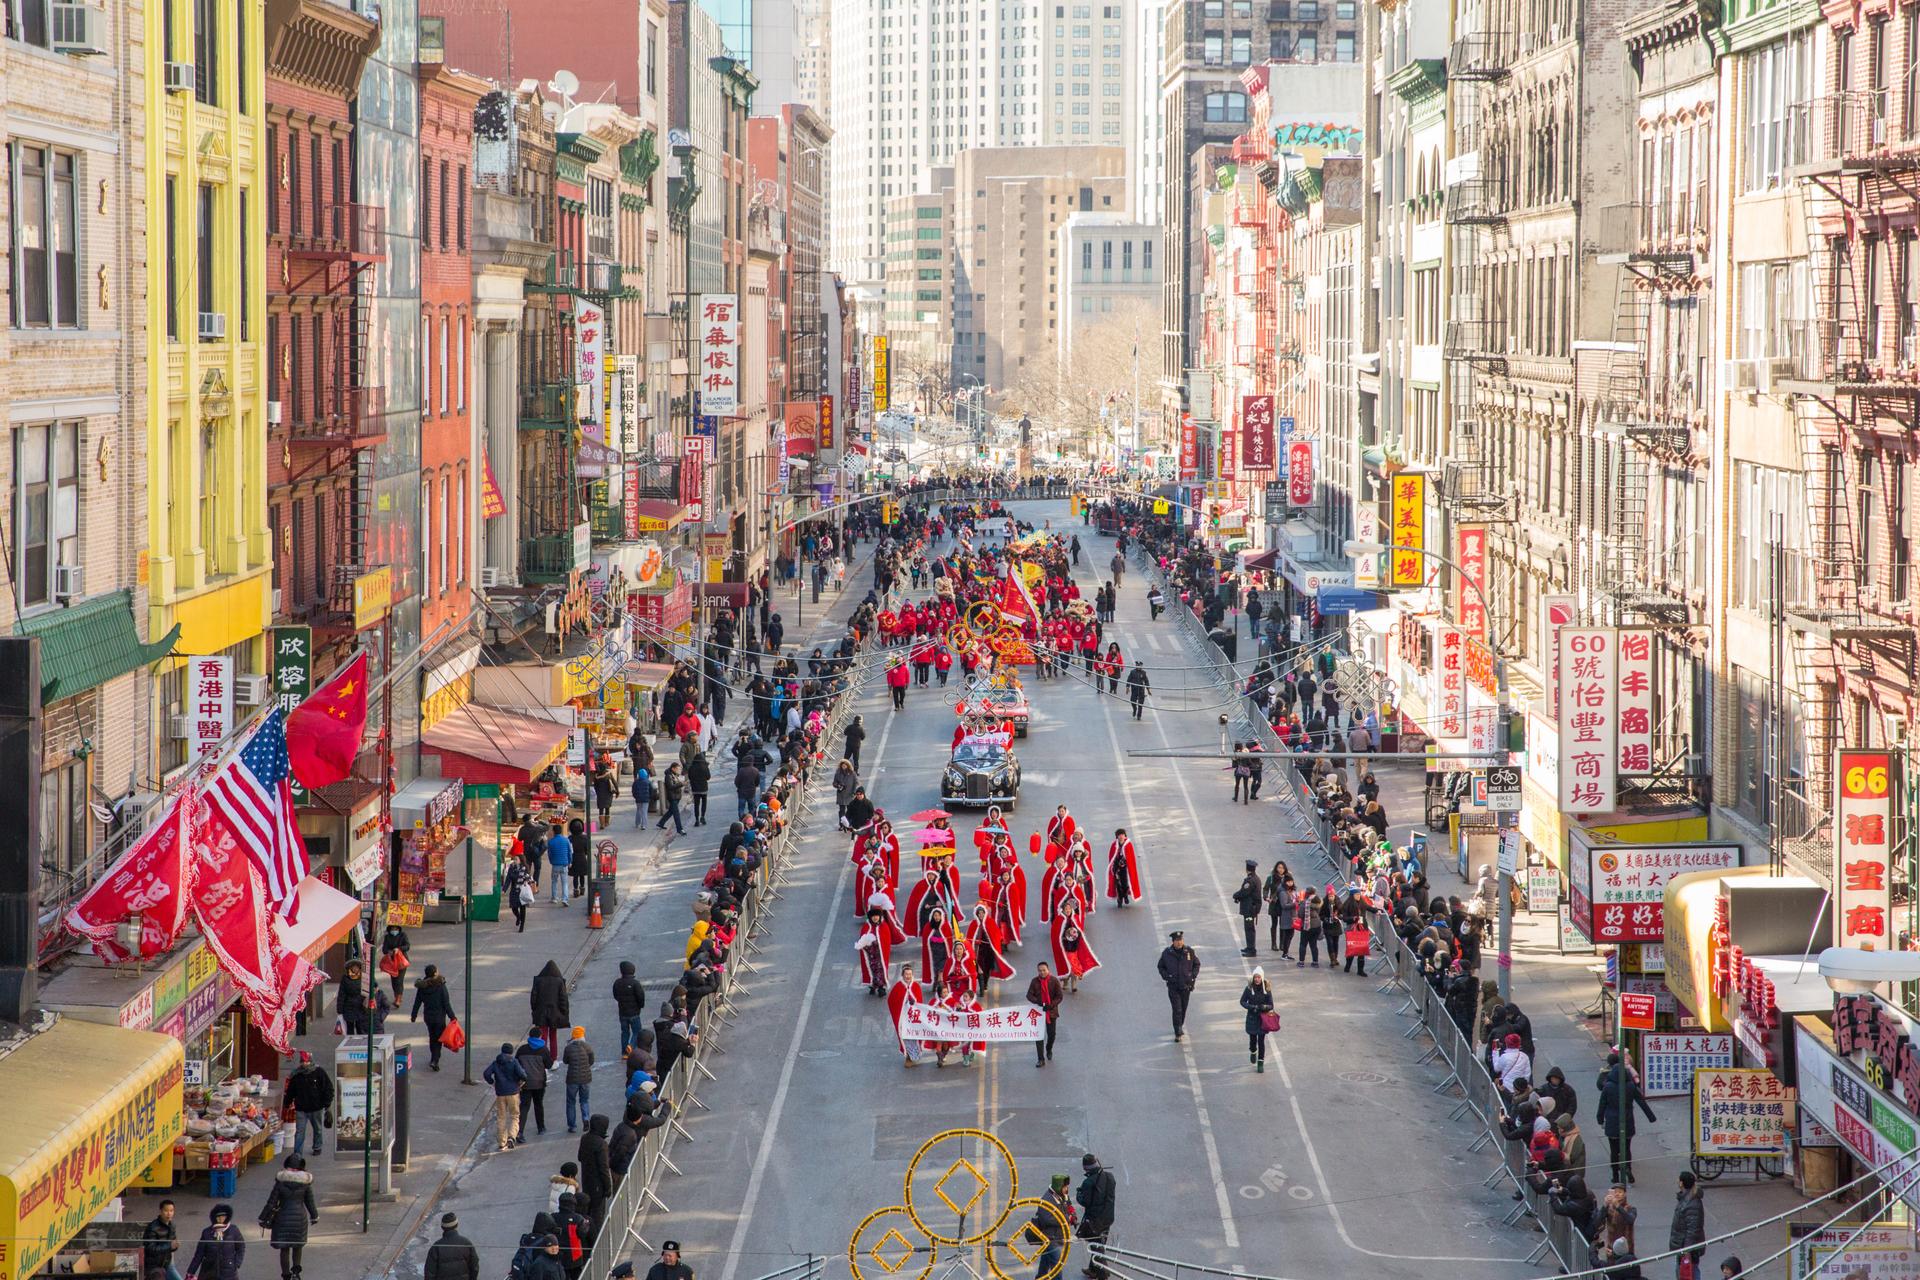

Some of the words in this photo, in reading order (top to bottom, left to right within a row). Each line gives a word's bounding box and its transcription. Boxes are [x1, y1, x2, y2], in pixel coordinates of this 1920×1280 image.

[1397, 480, 1420, 580] 華美商場
[1443, 632, 1461, 734] 興旺旺商場
[1846, 766, 1888, 794] 66
[1845, 813, 1885, 936] 福宝商
[1606, 927, 1618, 935] 62
[1633, 927, 1649, 935] TEL
[1626, 1003, 1649, 1011] ANYTIME
[1631, 996, 1653, 1004] STANDING
[906, 1006, 1043, 1030] 紐約中國旗袍會
[906, 1027, 919, 1036] NEW
[922, 1027, 938, 1037] YORK
[940, 1029, 965, 1039] CHINESE
[967, 1030, 987, 1040] QIPAO
[989, 1030, 1028, 1040] ASSOCIATION
[1029, 1029, 1040, 1038] INC
[1648, 1037, 1730, 1052] 福州大花店
[396, 1063, 404, 1074] P
[1865, 1056, 1884, 1090] 66
[1713, 1102, 1784, 1116] 快捷速遞
[1711, 1133, 1784, 1145] 郵寄全中國
